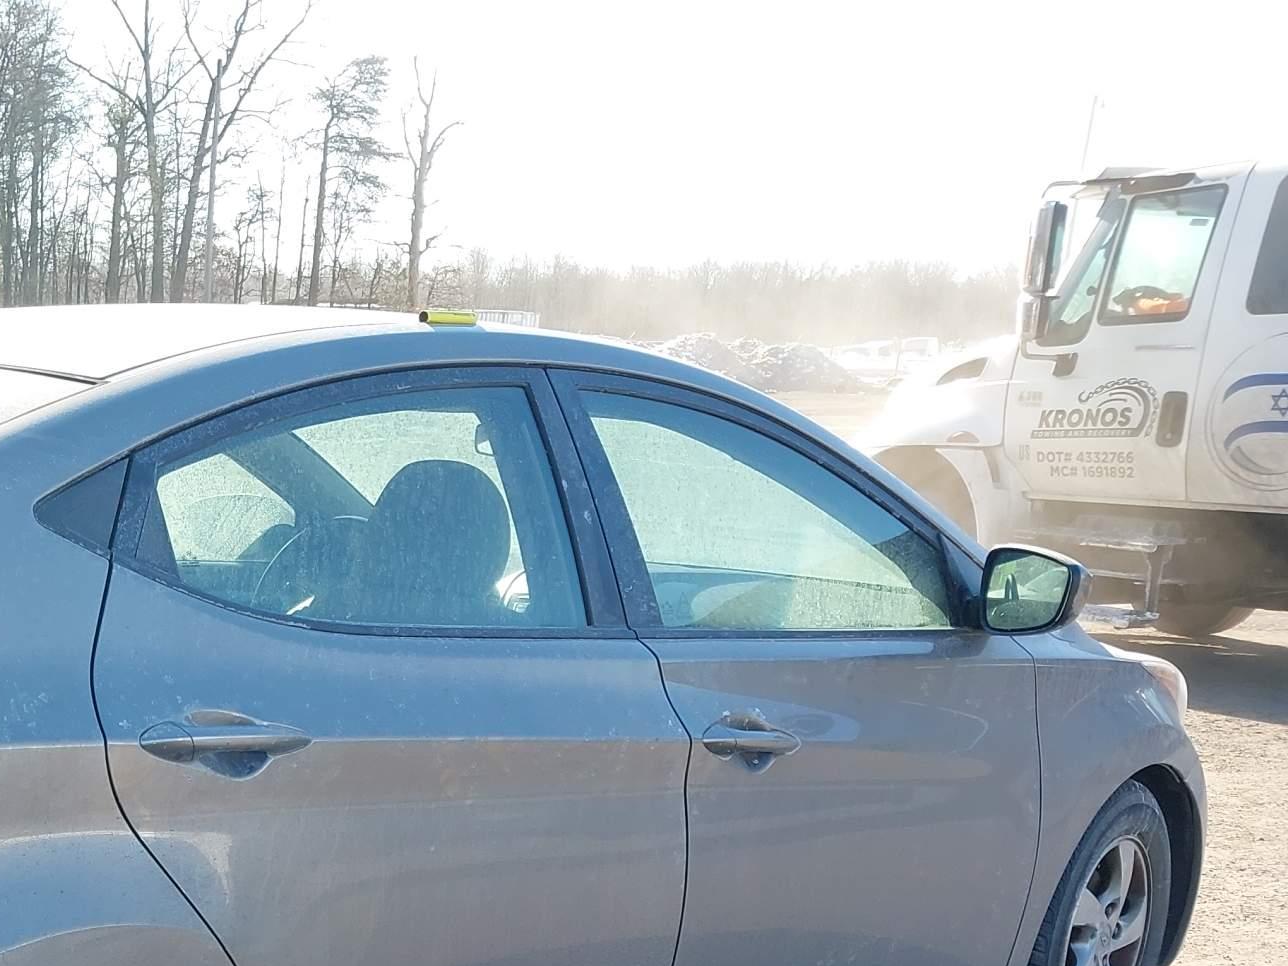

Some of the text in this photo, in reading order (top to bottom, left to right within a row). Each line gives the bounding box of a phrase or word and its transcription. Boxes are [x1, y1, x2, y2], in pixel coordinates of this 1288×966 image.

[1038, 407, 1133, 428] KRONOS
[1037, 451, 1072, 463] DOT#
[1076, 451, 1134, 463] 4332766
[1050, 466, 1135, 478] MC# 1691892
